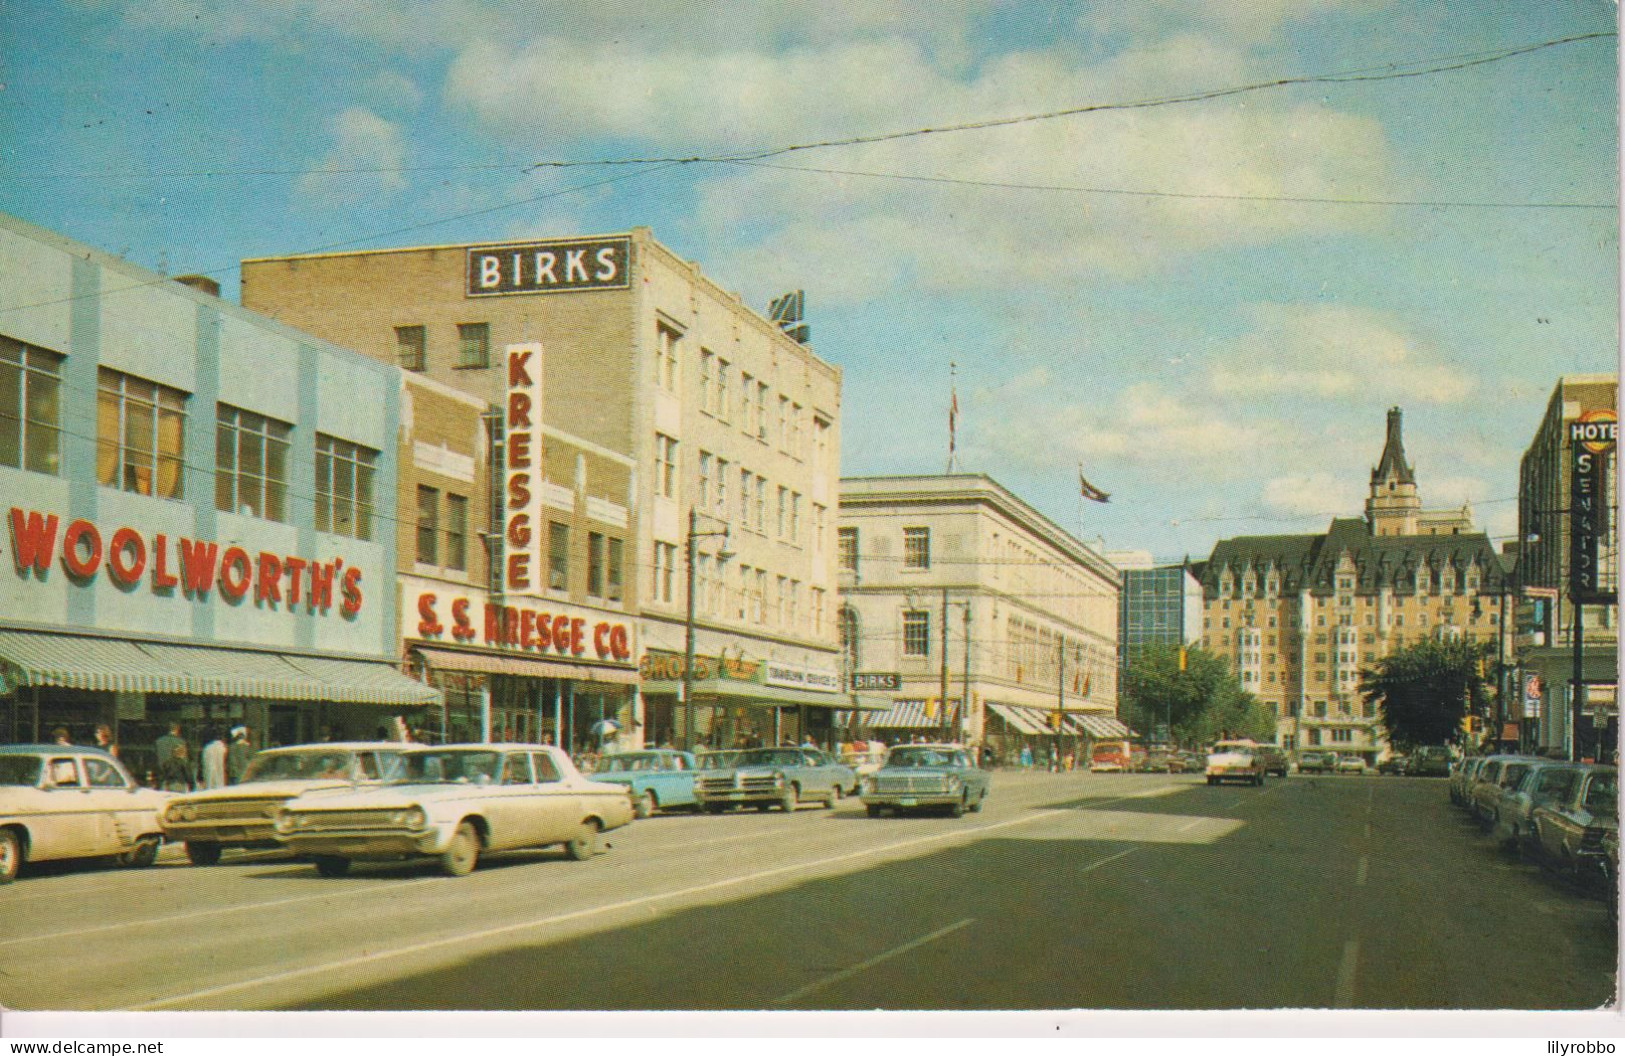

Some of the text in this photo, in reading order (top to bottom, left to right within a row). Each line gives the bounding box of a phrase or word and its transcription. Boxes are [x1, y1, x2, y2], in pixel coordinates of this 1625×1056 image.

[480, 247, 617, 288] BIRKS
[507, 350, 533, 591] KRESGE
[9, 506, 362, 617] WOOLWORTH'S
[484, 604, 585, 657] KRESGE
